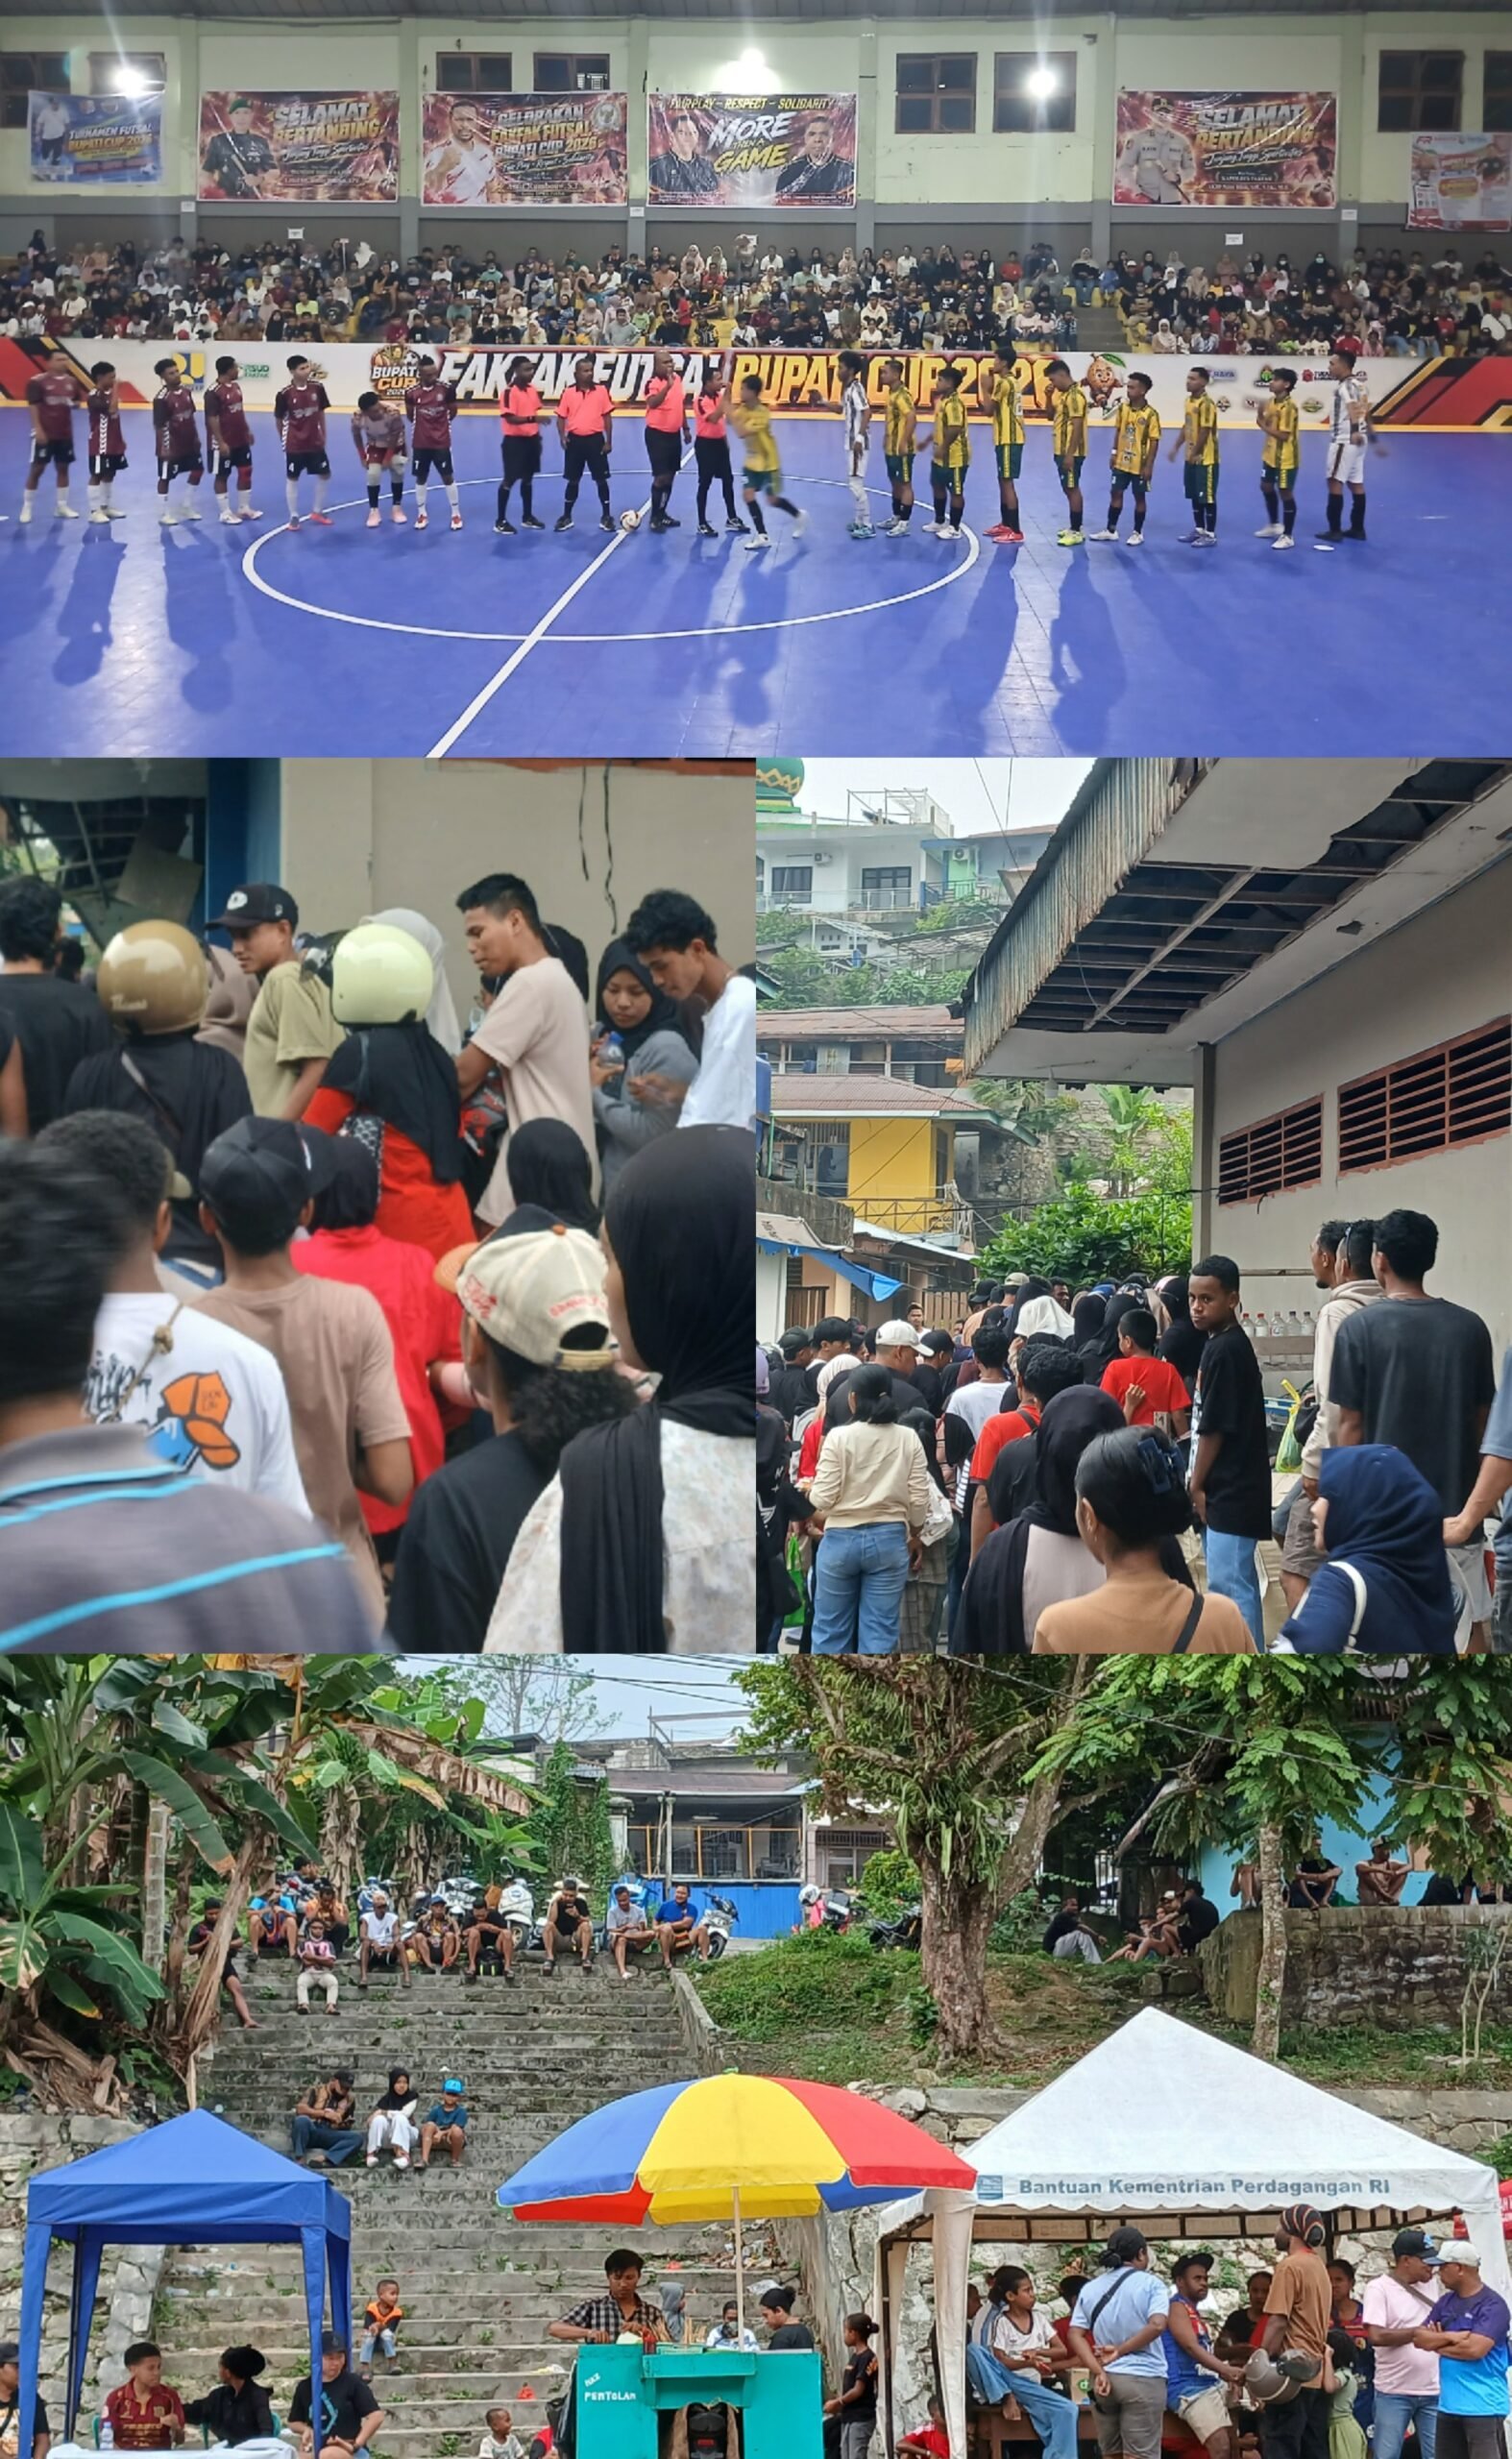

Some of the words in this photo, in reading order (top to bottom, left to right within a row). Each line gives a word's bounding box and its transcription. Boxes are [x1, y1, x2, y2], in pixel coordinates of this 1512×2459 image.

[275, 102, 370, 127] SELAMAT
[670, 98, 716, 110] FAIRPLAY
[724, 98, 767, 110] RESPECT
[778, 98, 834, 110] SOLIDARITY
[1198, 105, 1305, 129] SELAMAT
[274, 118, 381, 144] BERTANDING
[543, 121, 591, 139] FUTSAL
[706, 111, 796, 152] MORE
[1193, 123, 1315, 149] BERTANDING
[538, 139, 563, 155] CUP
[565, 136, 596, 153] 2026
[714, 143, 792, 174] GAME
[378, 377, 417, 391] CUP
[1019, 2179, 1102, 2194] Bantuan
[1110, 2179, 1225, 2194] Kementrian
[1231, 2179, 1363, 2197] Perdagangan
[1369, 2179, 1390, 2194] RI
